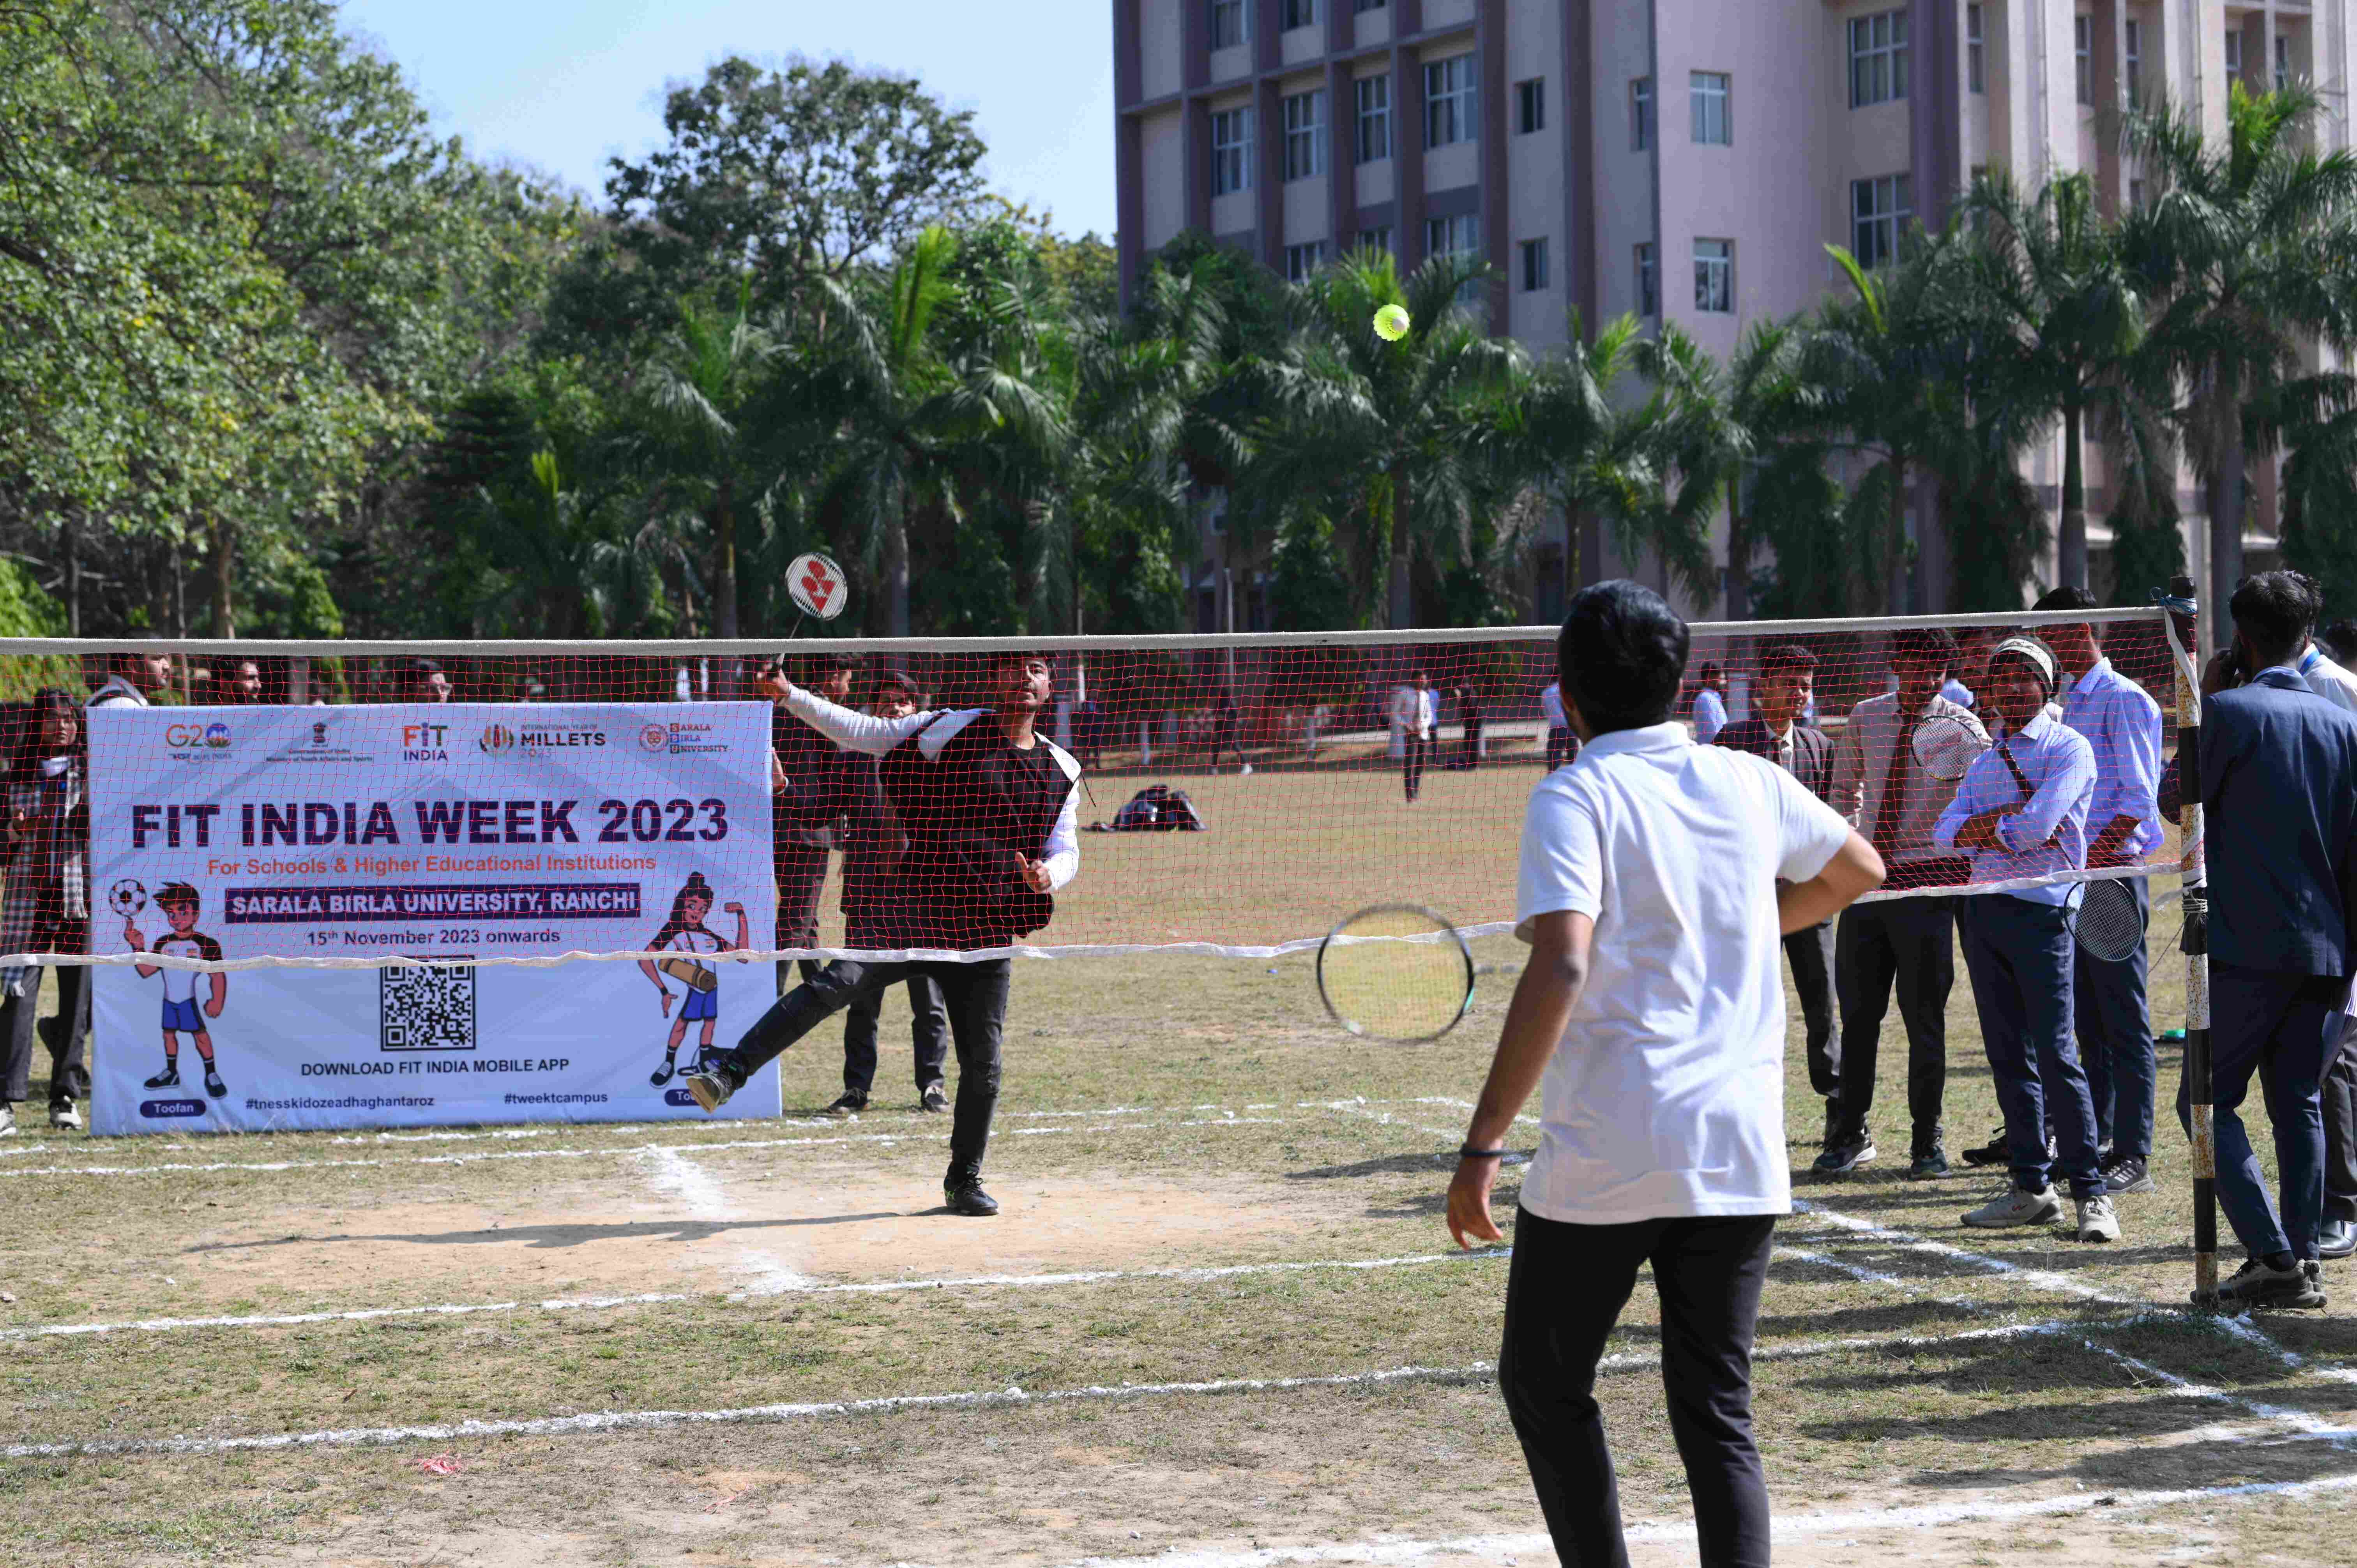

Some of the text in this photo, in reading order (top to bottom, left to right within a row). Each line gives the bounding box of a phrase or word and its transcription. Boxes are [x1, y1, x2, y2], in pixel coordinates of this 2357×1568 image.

[166, 723, 233, 748] G20
[521, 733, 606, 746] MILLETS
[404, 750, 447, 761] INDIA
[520, 747, 551, 758] 2023
[133, 798, 728, 847] FIT INDIA WEEK 2023
[208, 854, 656, 876] For Schools & Higher Educational Institutions
[232, 891, 635, 914] SARALA BIRLA UNIVERSITY, RANCHI
[345, 930, 433, 945] November
[440, 929, 480, 943] 2023
[486, 929, 560, 943] onwards
[300, 1059, 569, 1076] DOWNLOAD FIT INDIA MOBILE APP
[504, 1092, 608, 1105] #tweektcampus
[154, 1103, 194, 1114] Toofan
